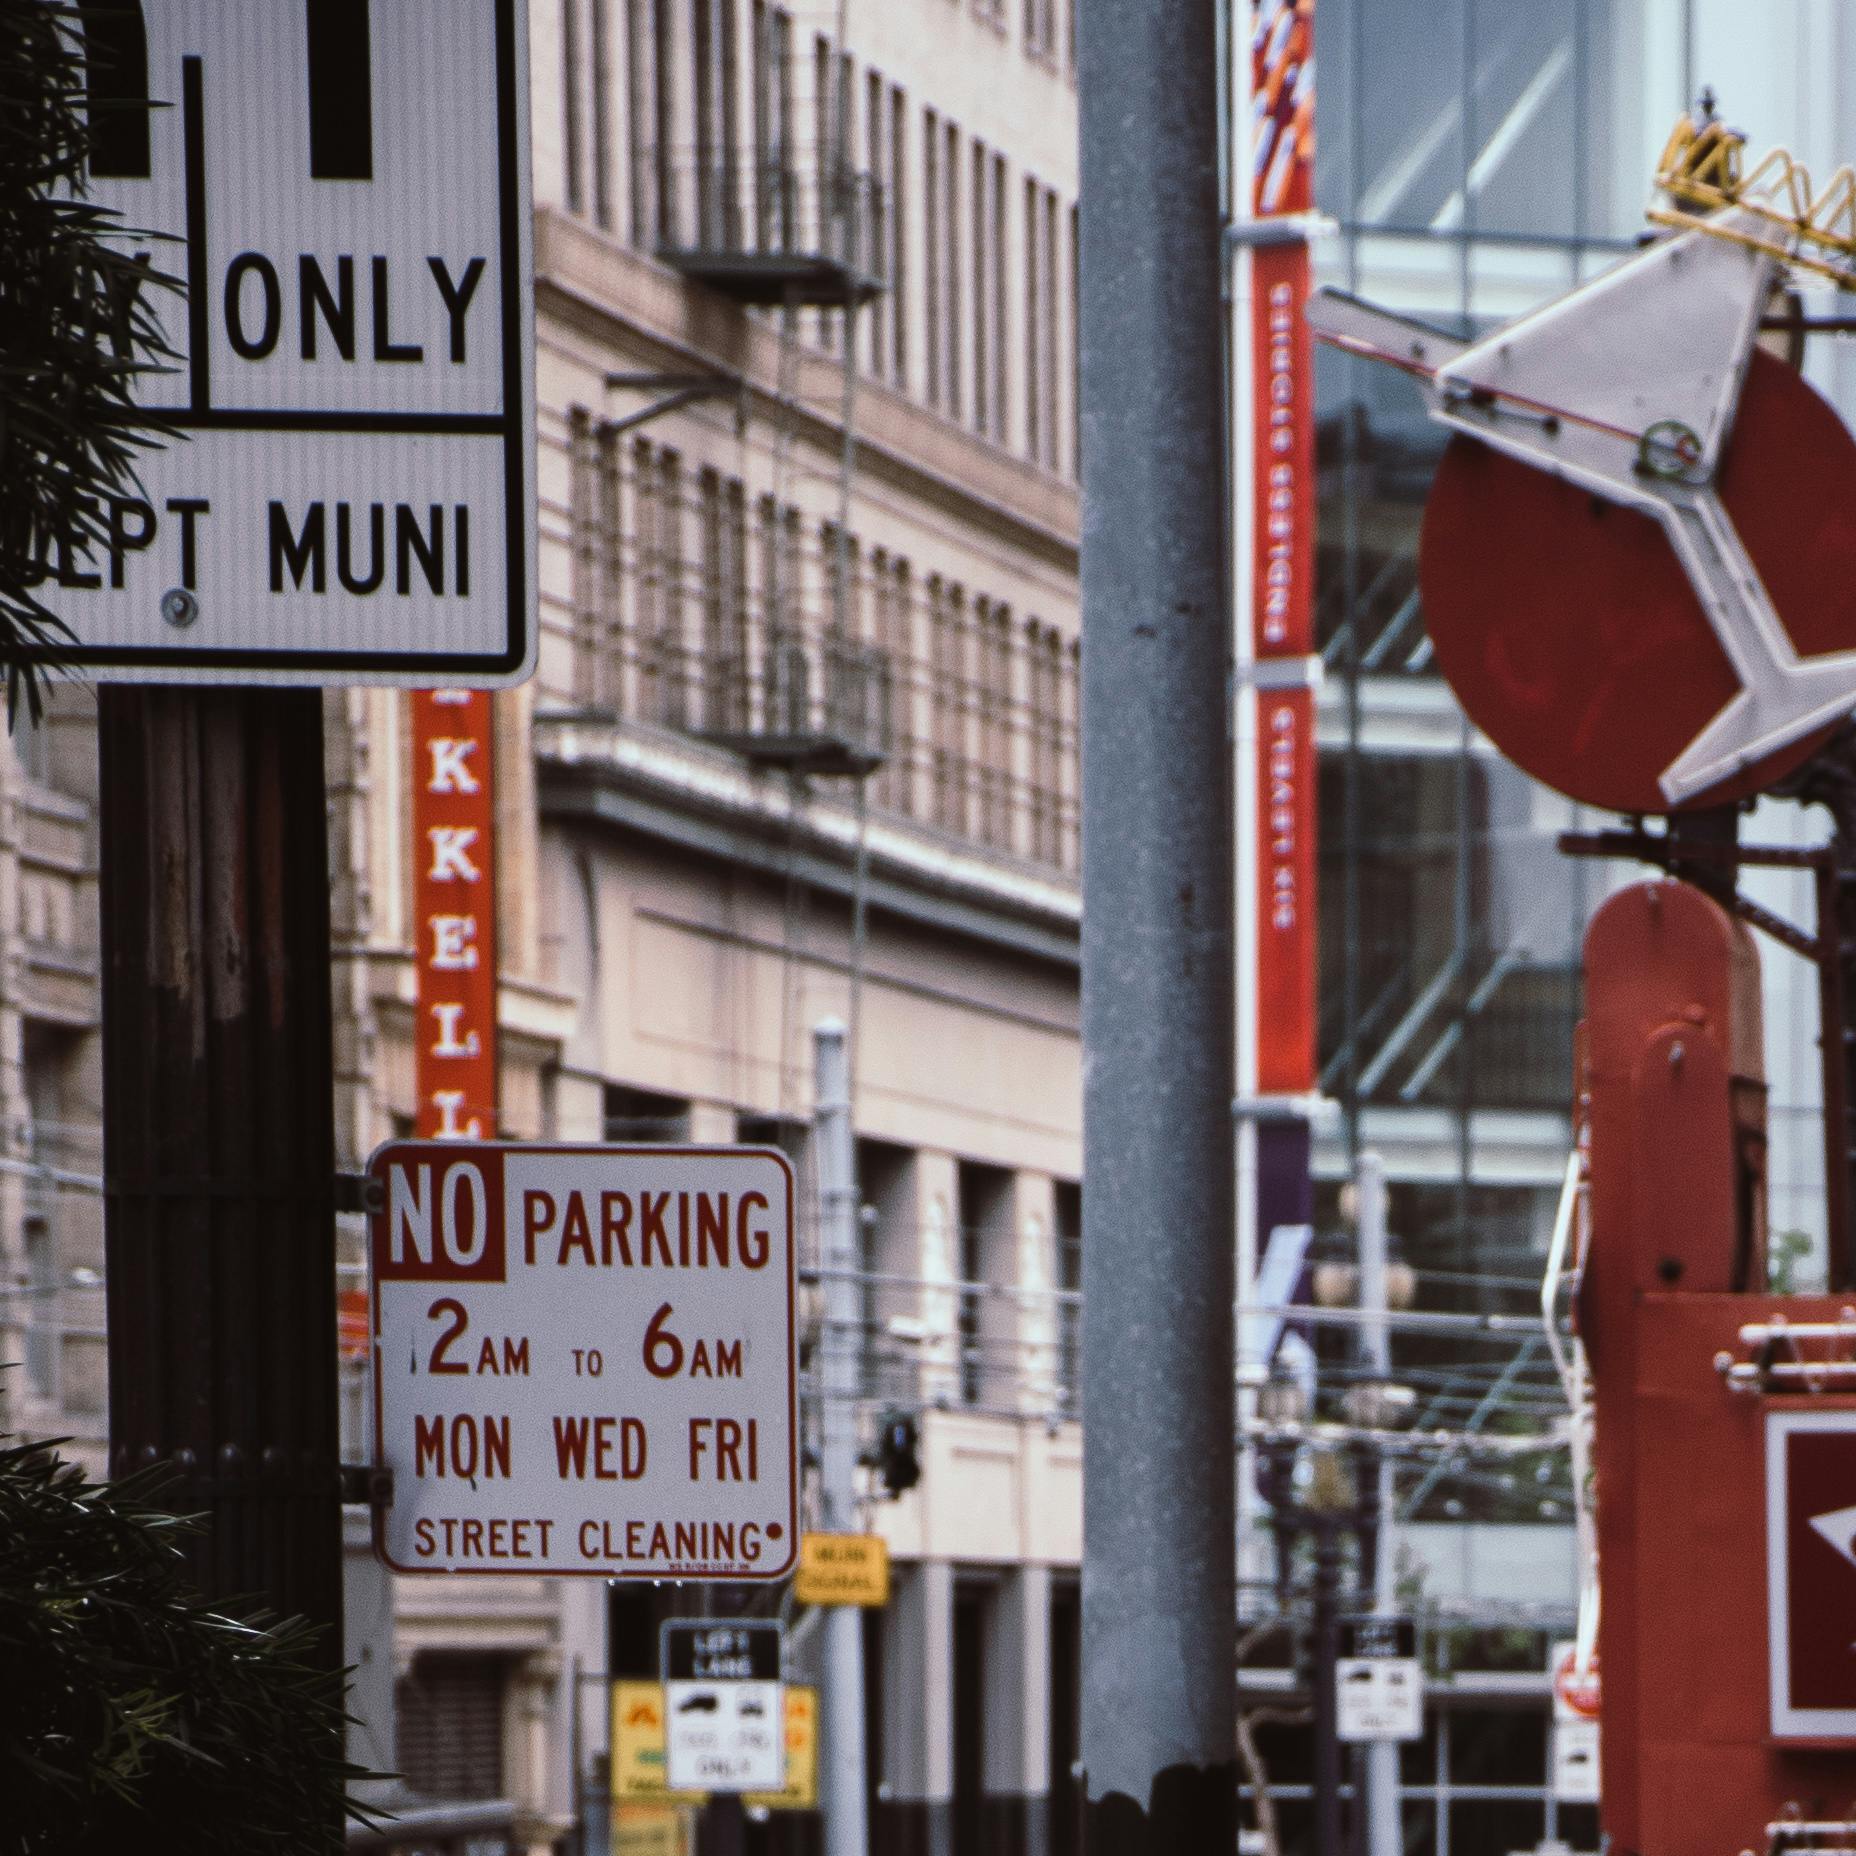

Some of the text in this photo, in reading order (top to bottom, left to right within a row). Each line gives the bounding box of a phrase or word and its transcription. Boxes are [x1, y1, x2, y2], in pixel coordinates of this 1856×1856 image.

[224, 252, 487, 364] ONLY
[269, 502, 469, 597] MUNI
[428, 692, 482, 1139] KKELL
[391, 1160, 769, 1268] NO PARKING
[427, 1297, 741, 1378] 2AM TO 6AM
[416, 1414, 757, 1481] MON WED FRI
[415, 1519, 761, 1561] STREET CLEANING
